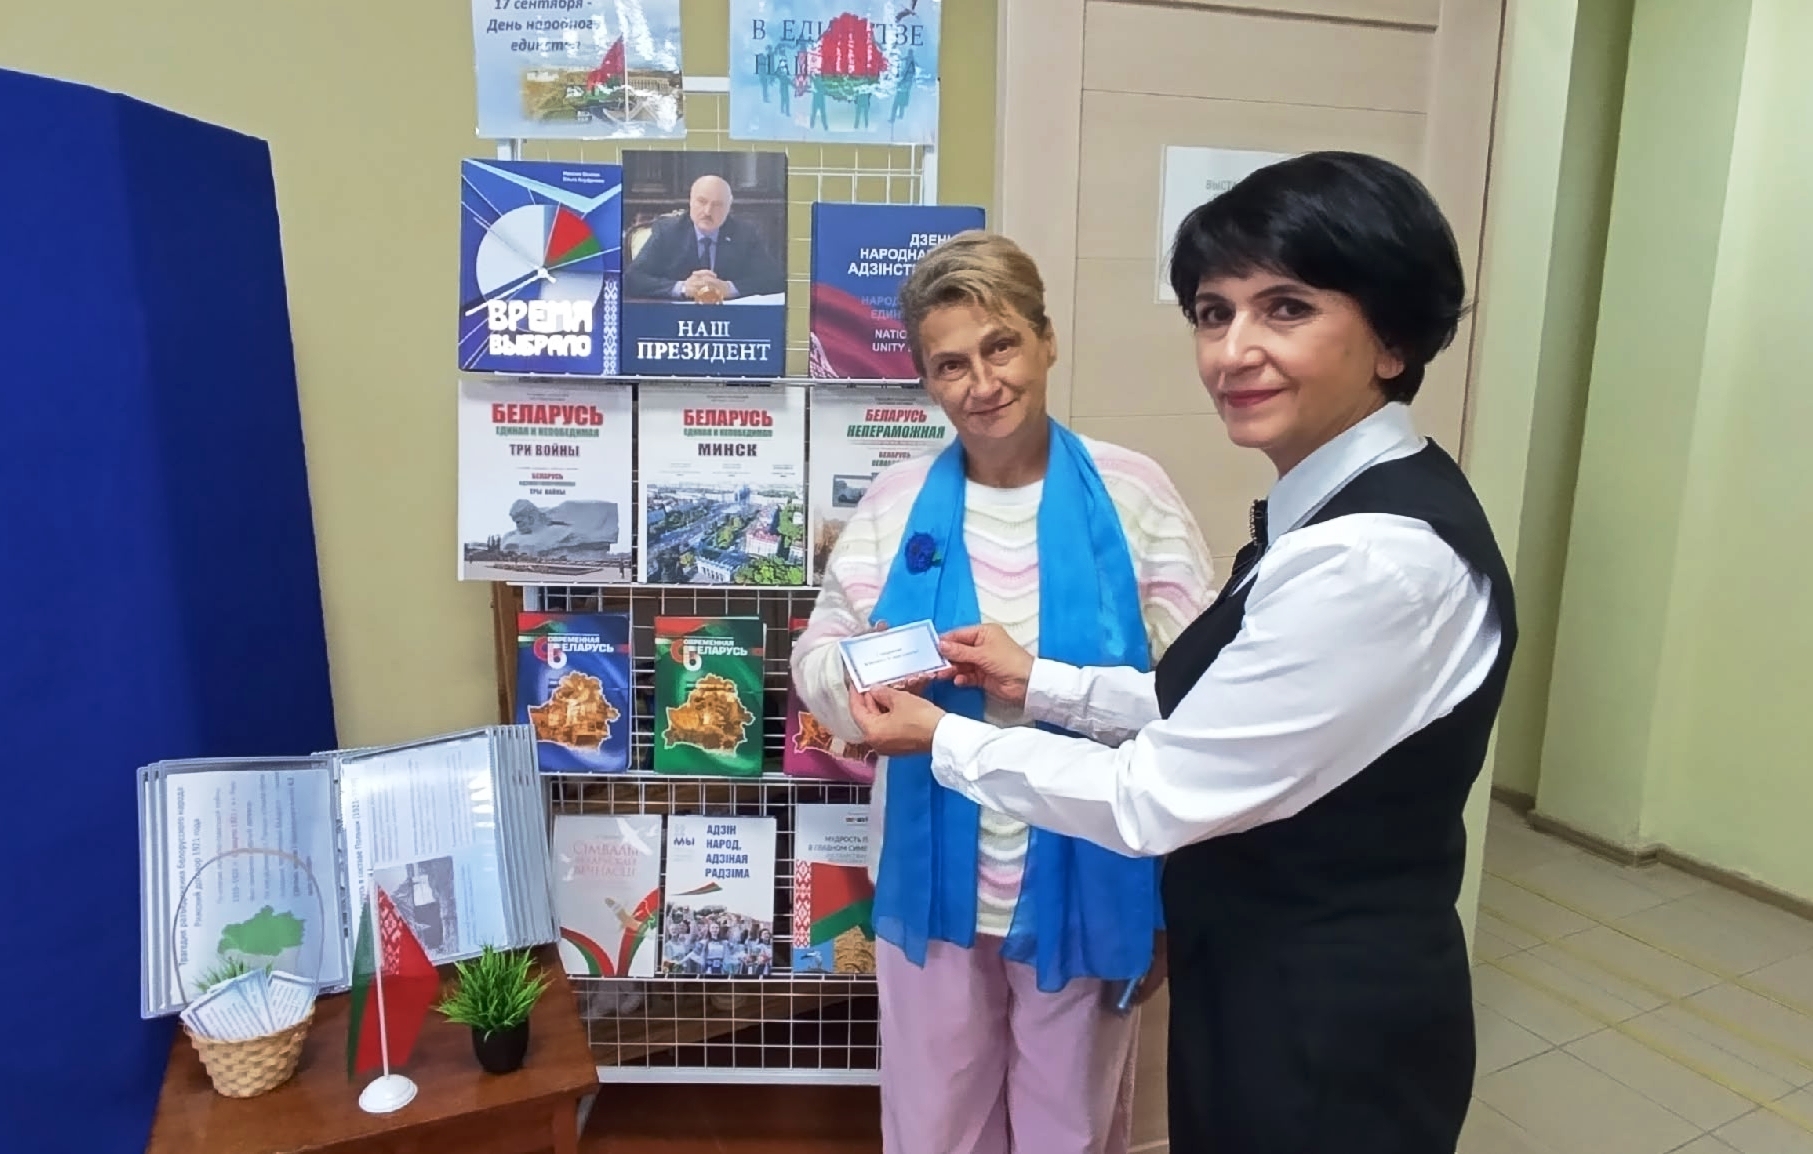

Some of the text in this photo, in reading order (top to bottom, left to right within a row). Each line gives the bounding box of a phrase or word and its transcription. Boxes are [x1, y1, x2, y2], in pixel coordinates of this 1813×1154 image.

[514, 0, 583, 11] сентября
[487, 18, 600, 33] День народног
[752, 19, 924, 46] В ЕДТВЕ
[910, 234, 952, 247] ДЗЕН
[848, 262, 917, 277] АДЗІНСТ
[488, 300, 593, 333] ВРЕМЯ
[678, 320, 730, 337] НАШ
[489, 334, 592, 356] ВЫБРАЛО
[872, 343, 905, 352] UNITY
[637, 342, 771, 364] ПРЕЗИДЕНТ
[492, 403, 603, 426] БЕЛАРУСЬ
[683, 408, 773, 427] БЕЛАРУСЬ
[865, 408, 928, 423] БЕЛАРУСЬ
[496, 426, 529, 437] ЕДИНАЯ
[538, 427, 600, 438] НЕПОБЕДИМАЯ
[846, 425, 946, 438] НЕПЕРАМОЖНАЯ
[509, 443, 580, 457] ТРИ ВОЙНЫ
[698, 443, 757, 457] МИНСК
[706, 825, 737, 836] АДЗІН
[705, 853, 749, 864] АДЗІНАЯ
[705, 868, 750, 879] РАДЗІМА
